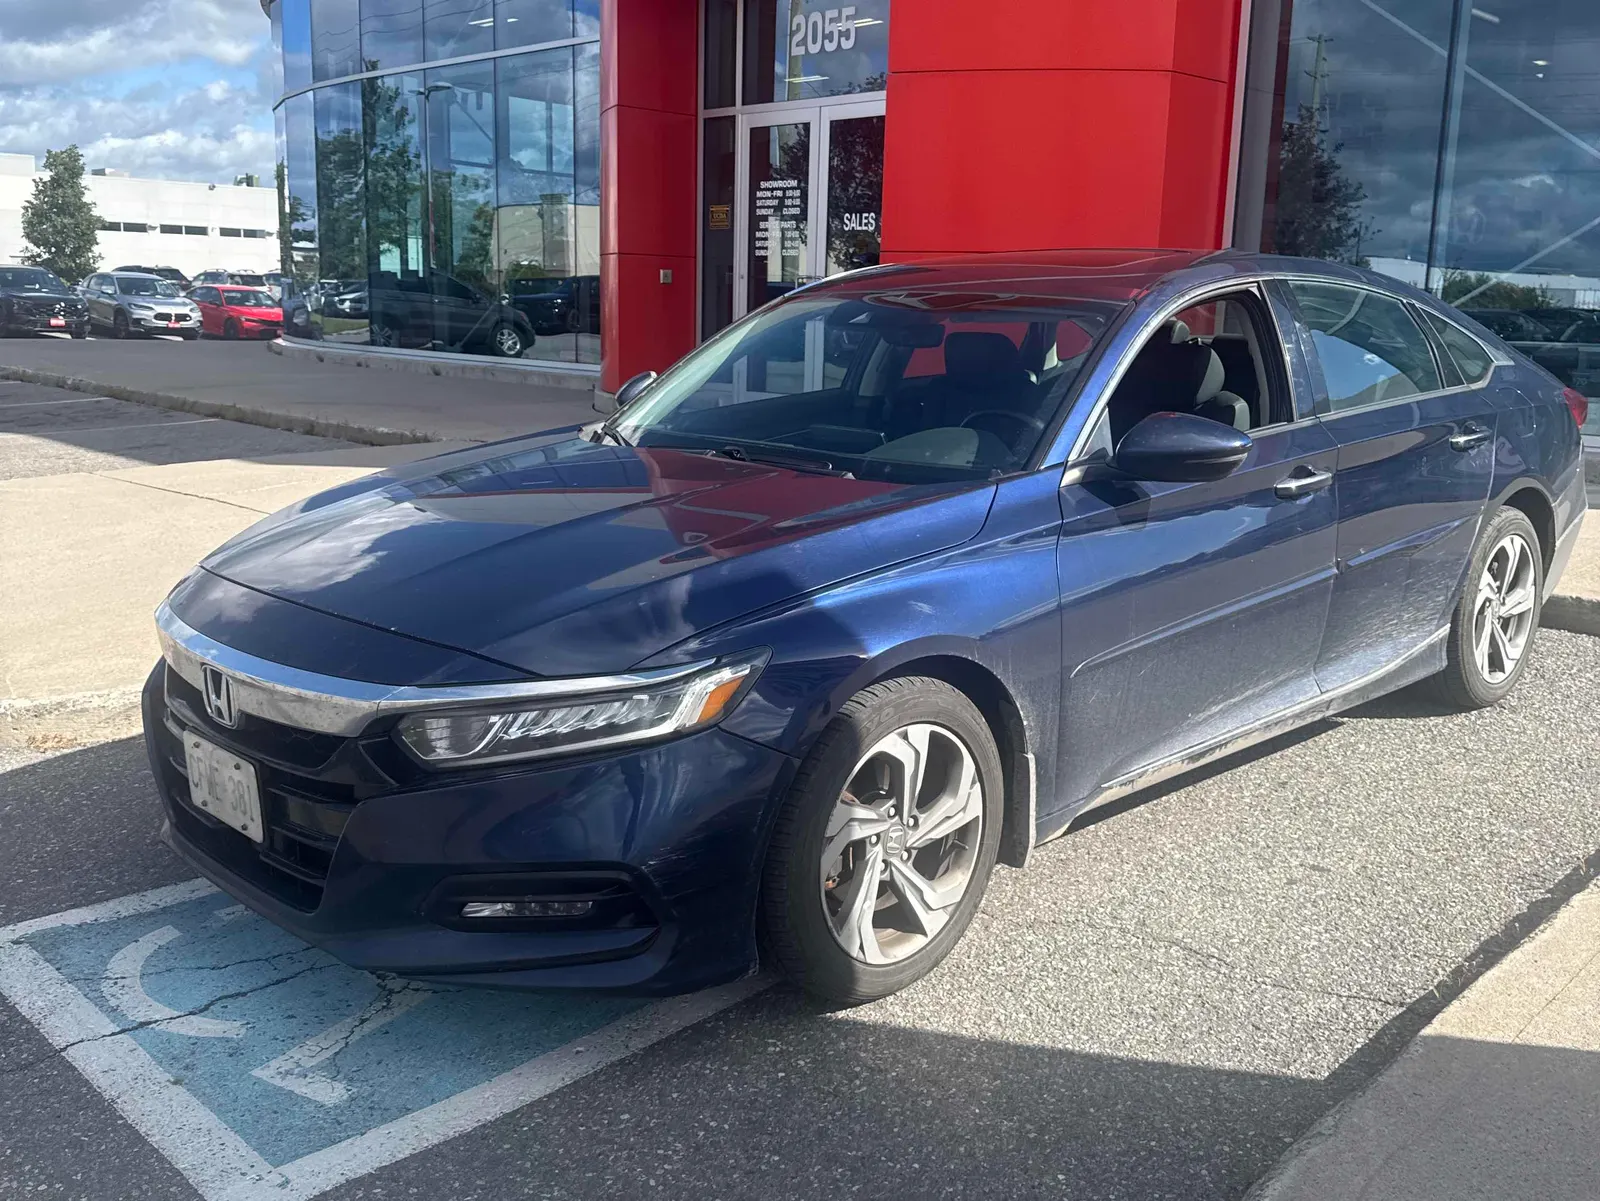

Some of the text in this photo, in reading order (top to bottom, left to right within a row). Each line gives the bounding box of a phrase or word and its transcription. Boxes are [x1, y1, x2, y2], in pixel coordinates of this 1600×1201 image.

[791, 6, 856, 56] 2055
[760, 180, 798, 188] SHOWROOM
[756, 190, 783, 198] MON-FRI
[756, 199, 779, 207] SATURDAY
[756, 207, 801, 216] SUNDAY CLOSED
[780, 220, 797, 229] PARTS
[843, 212, 876, 231] SALES
[228, 775, 255, 823] 381
